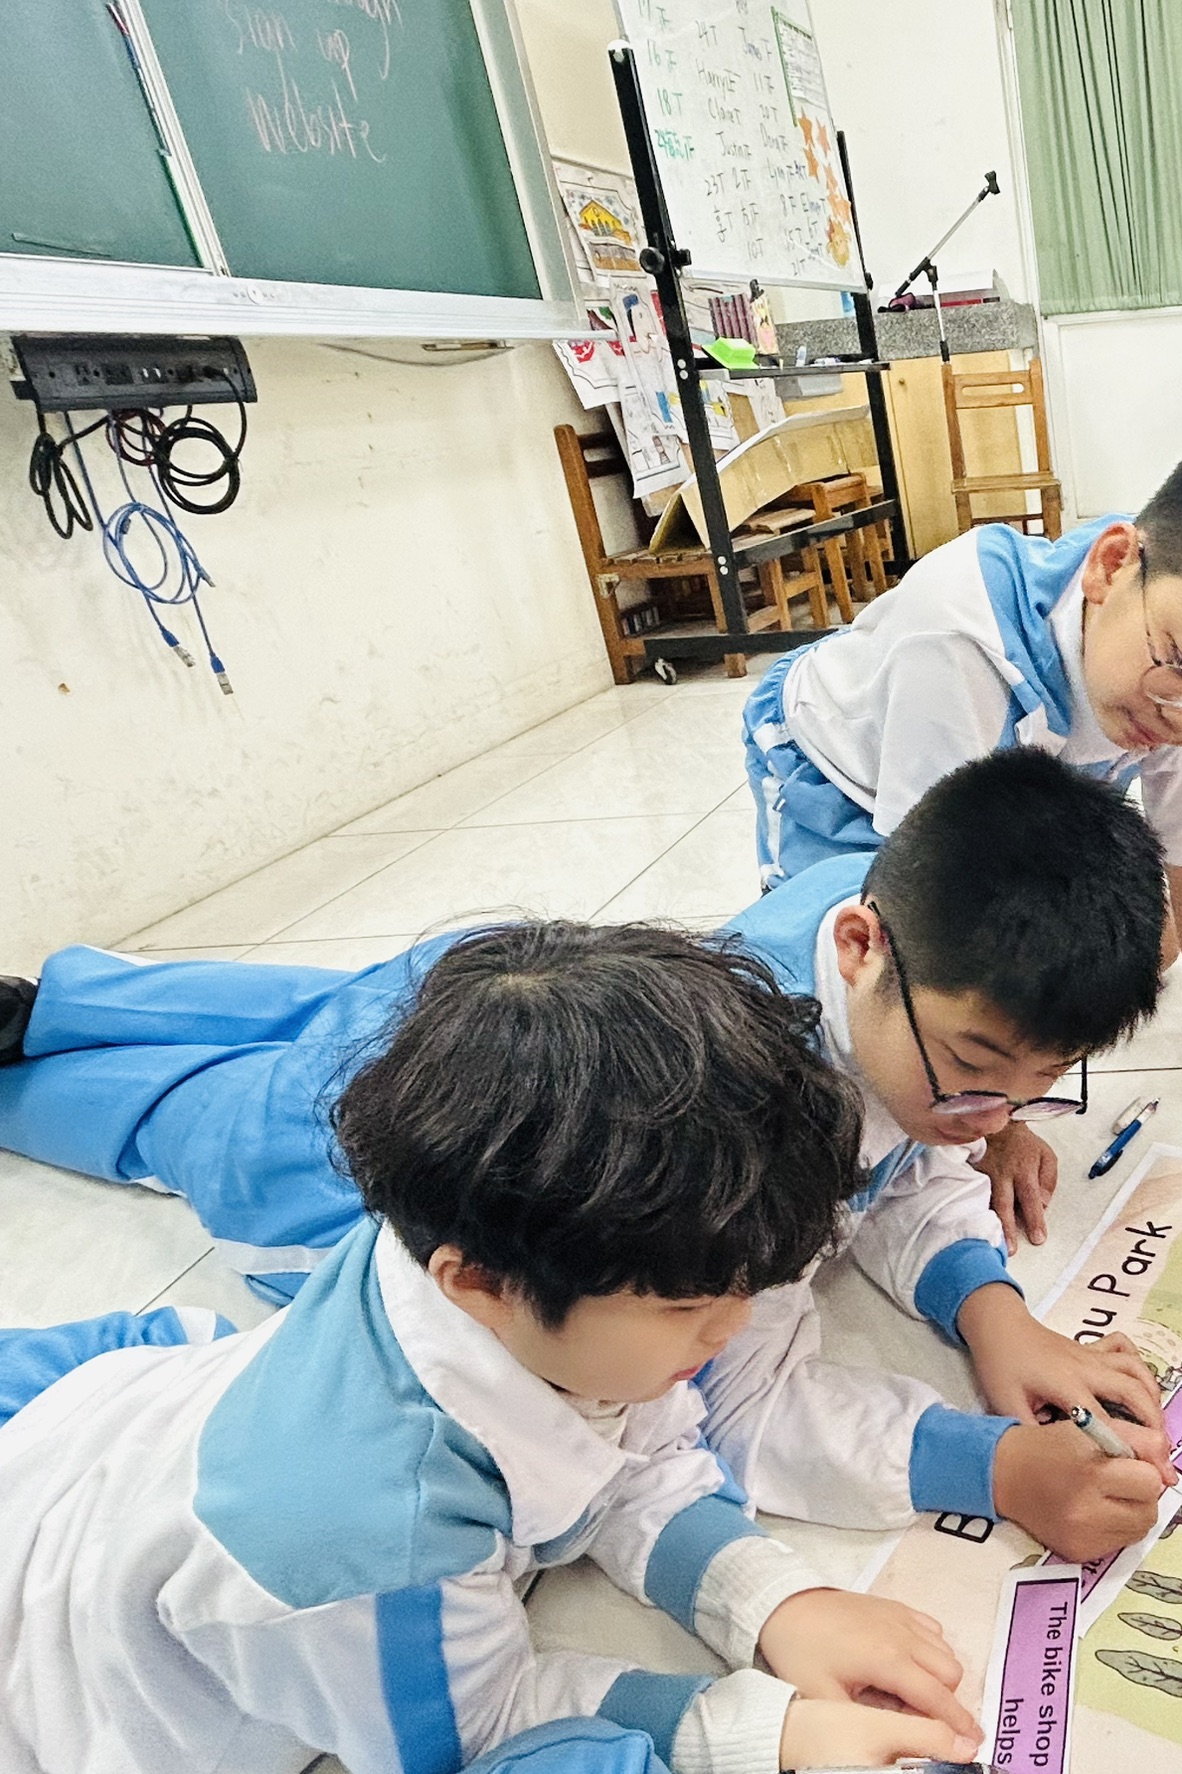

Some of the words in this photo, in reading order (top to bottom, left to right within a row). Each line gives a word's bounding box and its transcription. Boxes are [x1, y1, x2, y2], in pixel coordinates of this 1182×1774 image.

[1087, 1221, 1172, 1297] Park
[1046, 1601, 1068, 1640] The
[1040, 1647, 1063, 1696] bike
[997, 1698, 1025, 1765] helps
[1029, 1705, 1058, 1767] shop
